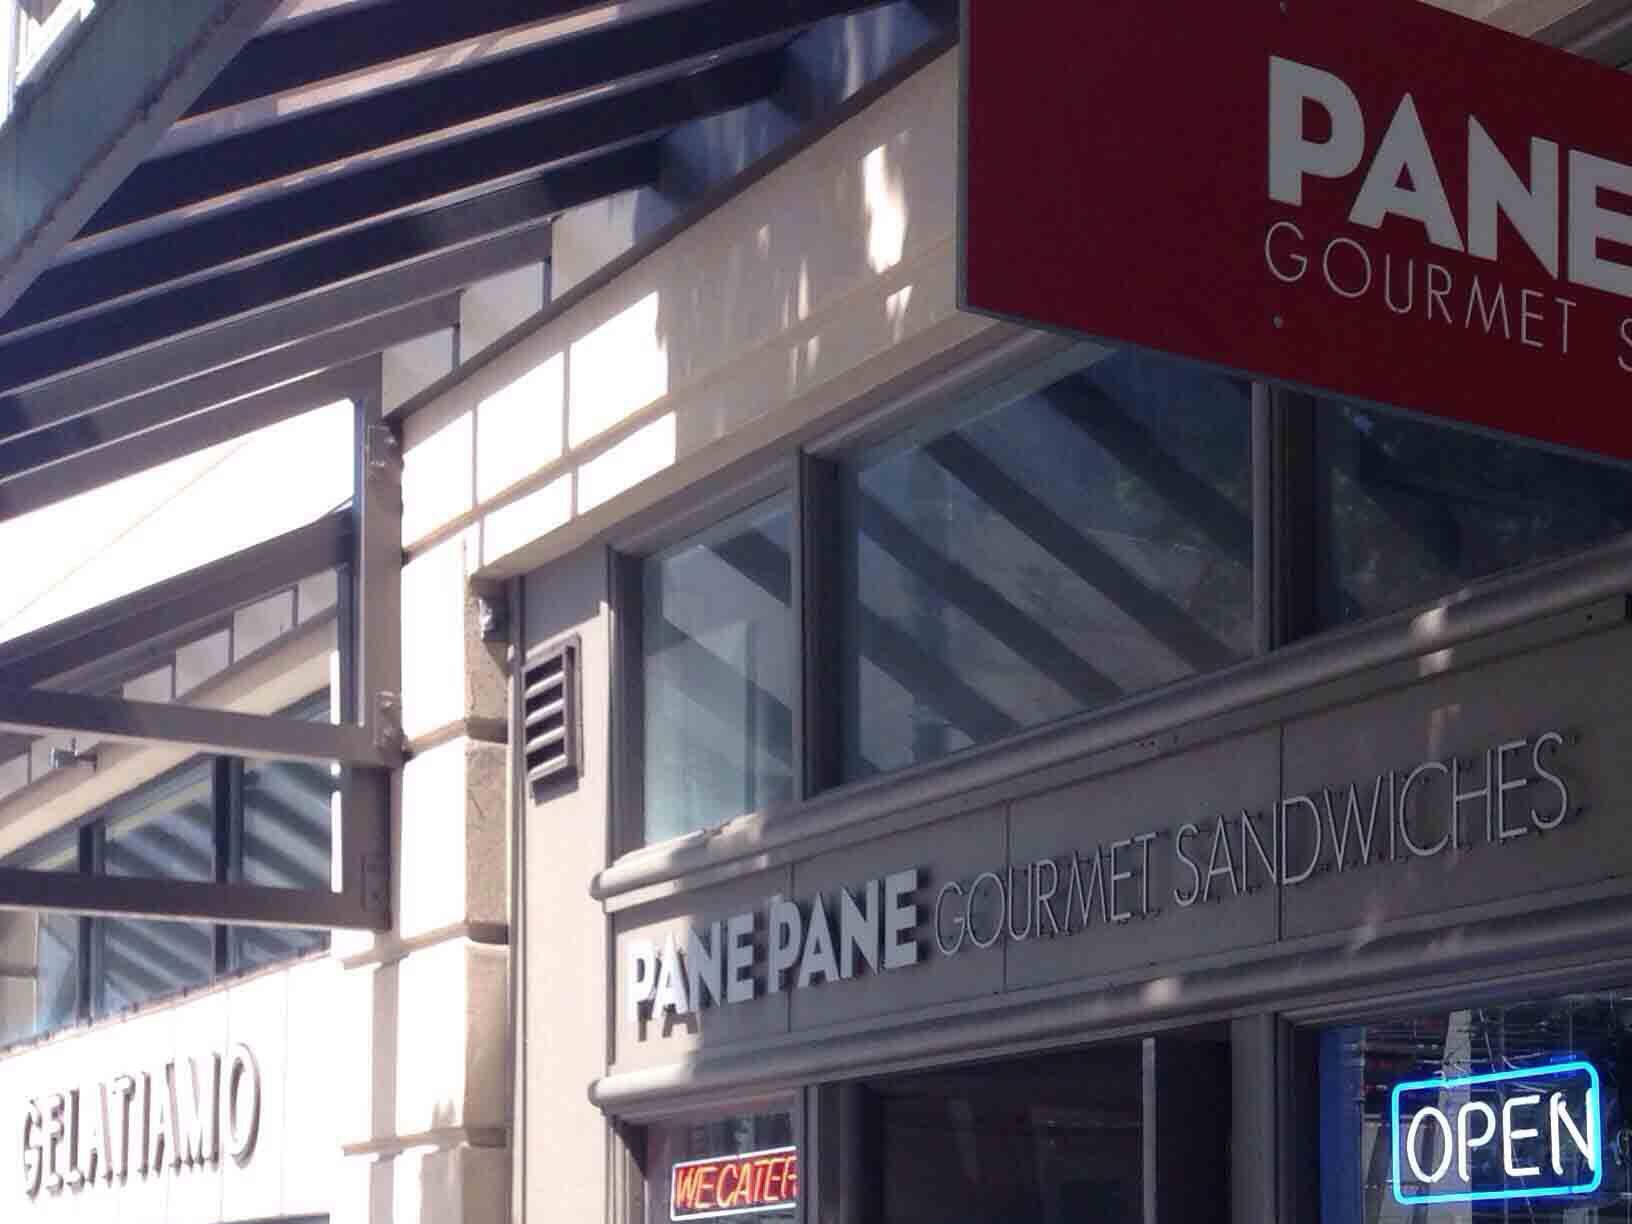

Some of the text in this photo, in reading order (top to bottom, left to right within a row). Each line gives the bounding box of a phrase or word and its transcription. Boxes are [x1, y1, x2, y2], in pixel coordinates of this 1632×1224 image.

[1264, 221, 1577, 354] GOURMET
[627, 730, 1569, 1014] PANE PANE GOURMET SANDWICHES
[22, 1041, 261, 1199] GELATIAMO
[1406, 1088, 1596, 1183] OPEN
